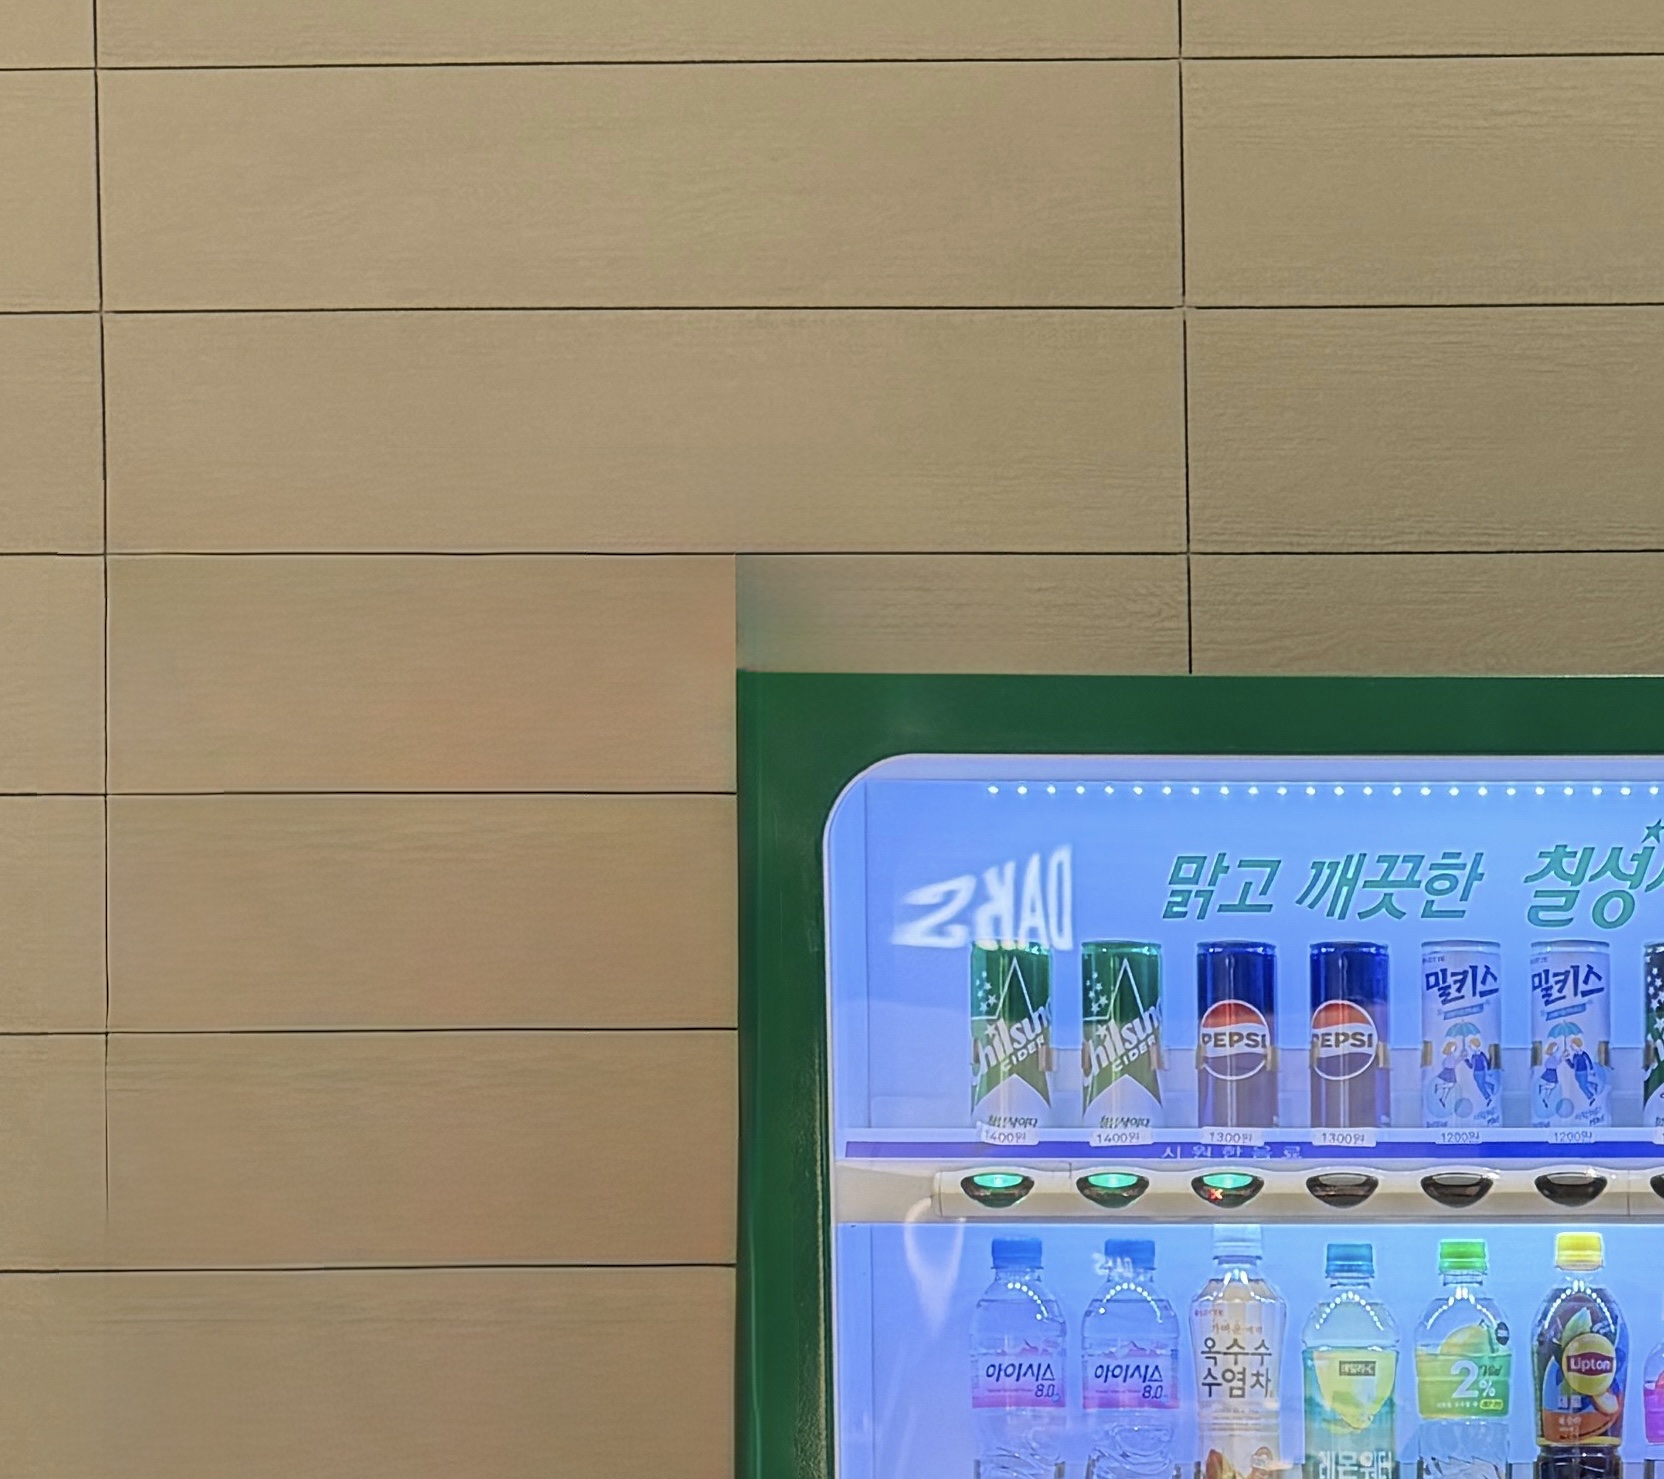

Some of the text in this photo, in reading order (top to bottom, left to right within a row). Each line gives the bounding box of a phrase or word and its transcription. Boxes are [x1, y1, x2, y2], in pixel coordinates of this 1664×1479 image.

[1163, 852, 1281, 921] 맑고
[1295, 851, 1487, 921] 깨끗한
[1425, 964, 1500, 1006] 밀키스
[1531, 963, 1604, 1007] 밀키스
[1097, 1131, 1140, 1143] 1400원
[1209, 1132, 1252, 1143] 1300원
[1322, 1132, 1365, 1144] 1300원
[1200, 1337, 1273, 1366] 옥수수
[986, 1363, 1055, 1382] 아이시스
[1094, 1364, 1163, 1383] 아이시스
[1570, 1357, 1611, 1372] Lipton
[1201, 1366, 1272, 1398] 수염차
[1450, 1360, 1496, 1398] 2%
[1034, 1384, 1055, 1398] 8.0
[1142, 1385, 1163, 1399] 8.0
